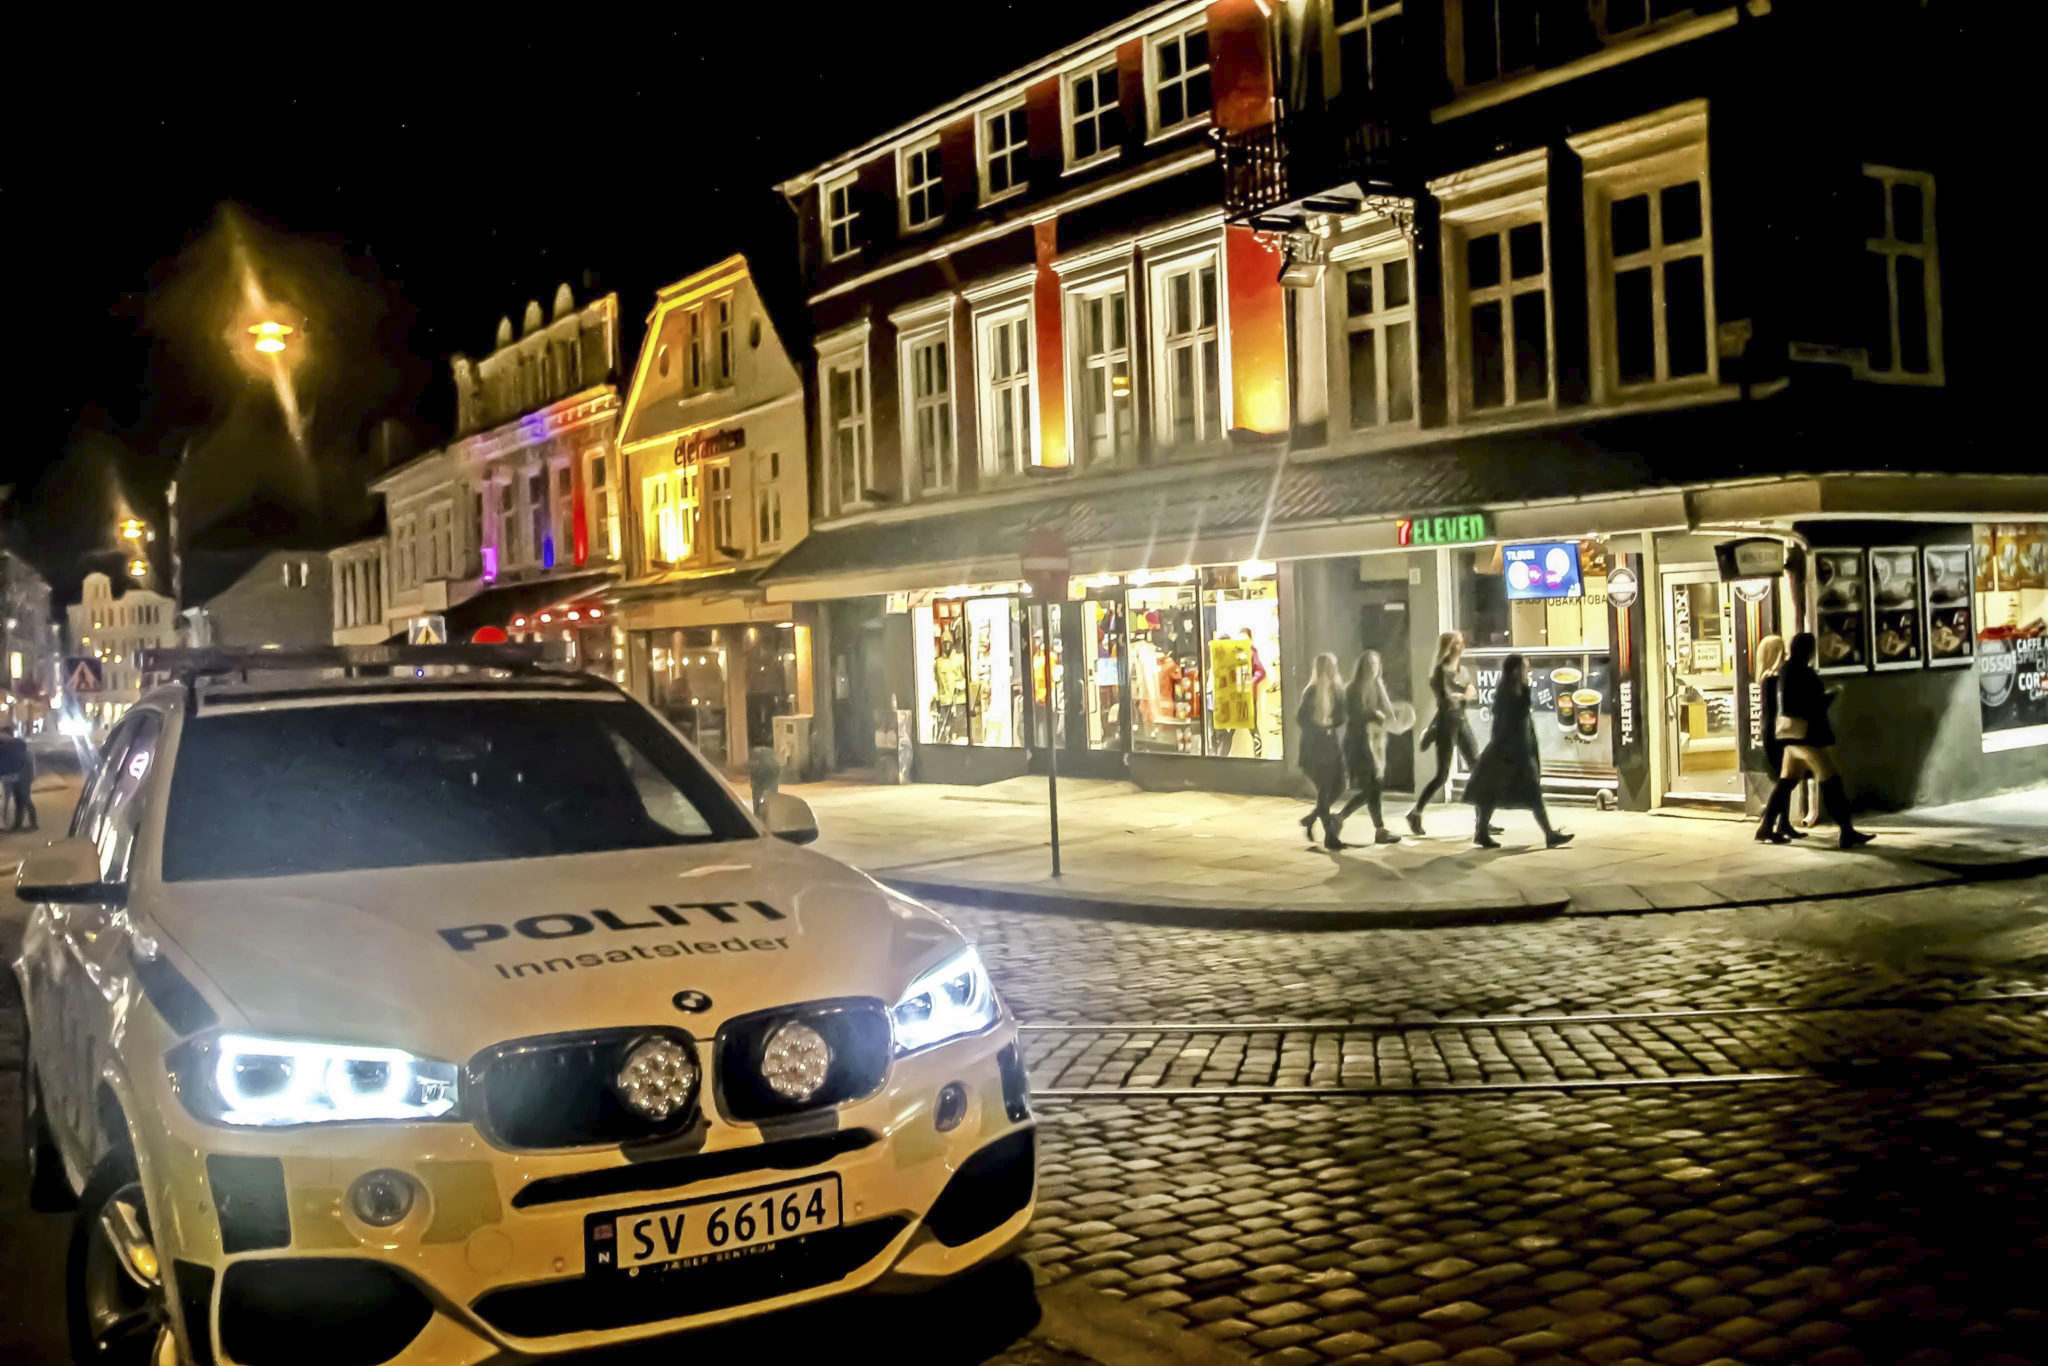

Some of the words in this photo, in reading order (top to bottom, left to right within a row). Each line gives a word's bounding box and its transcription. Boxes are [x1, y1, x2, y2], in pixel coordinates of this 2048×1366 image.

[436, 900, 787, 953] POLITI
[494, 936, 790, 980] Innsatsleder
[633, 1214, 686, 1260] SV
[706, 1187, 826, 1247] 66164
[598, 1252, 611, 1264] N
